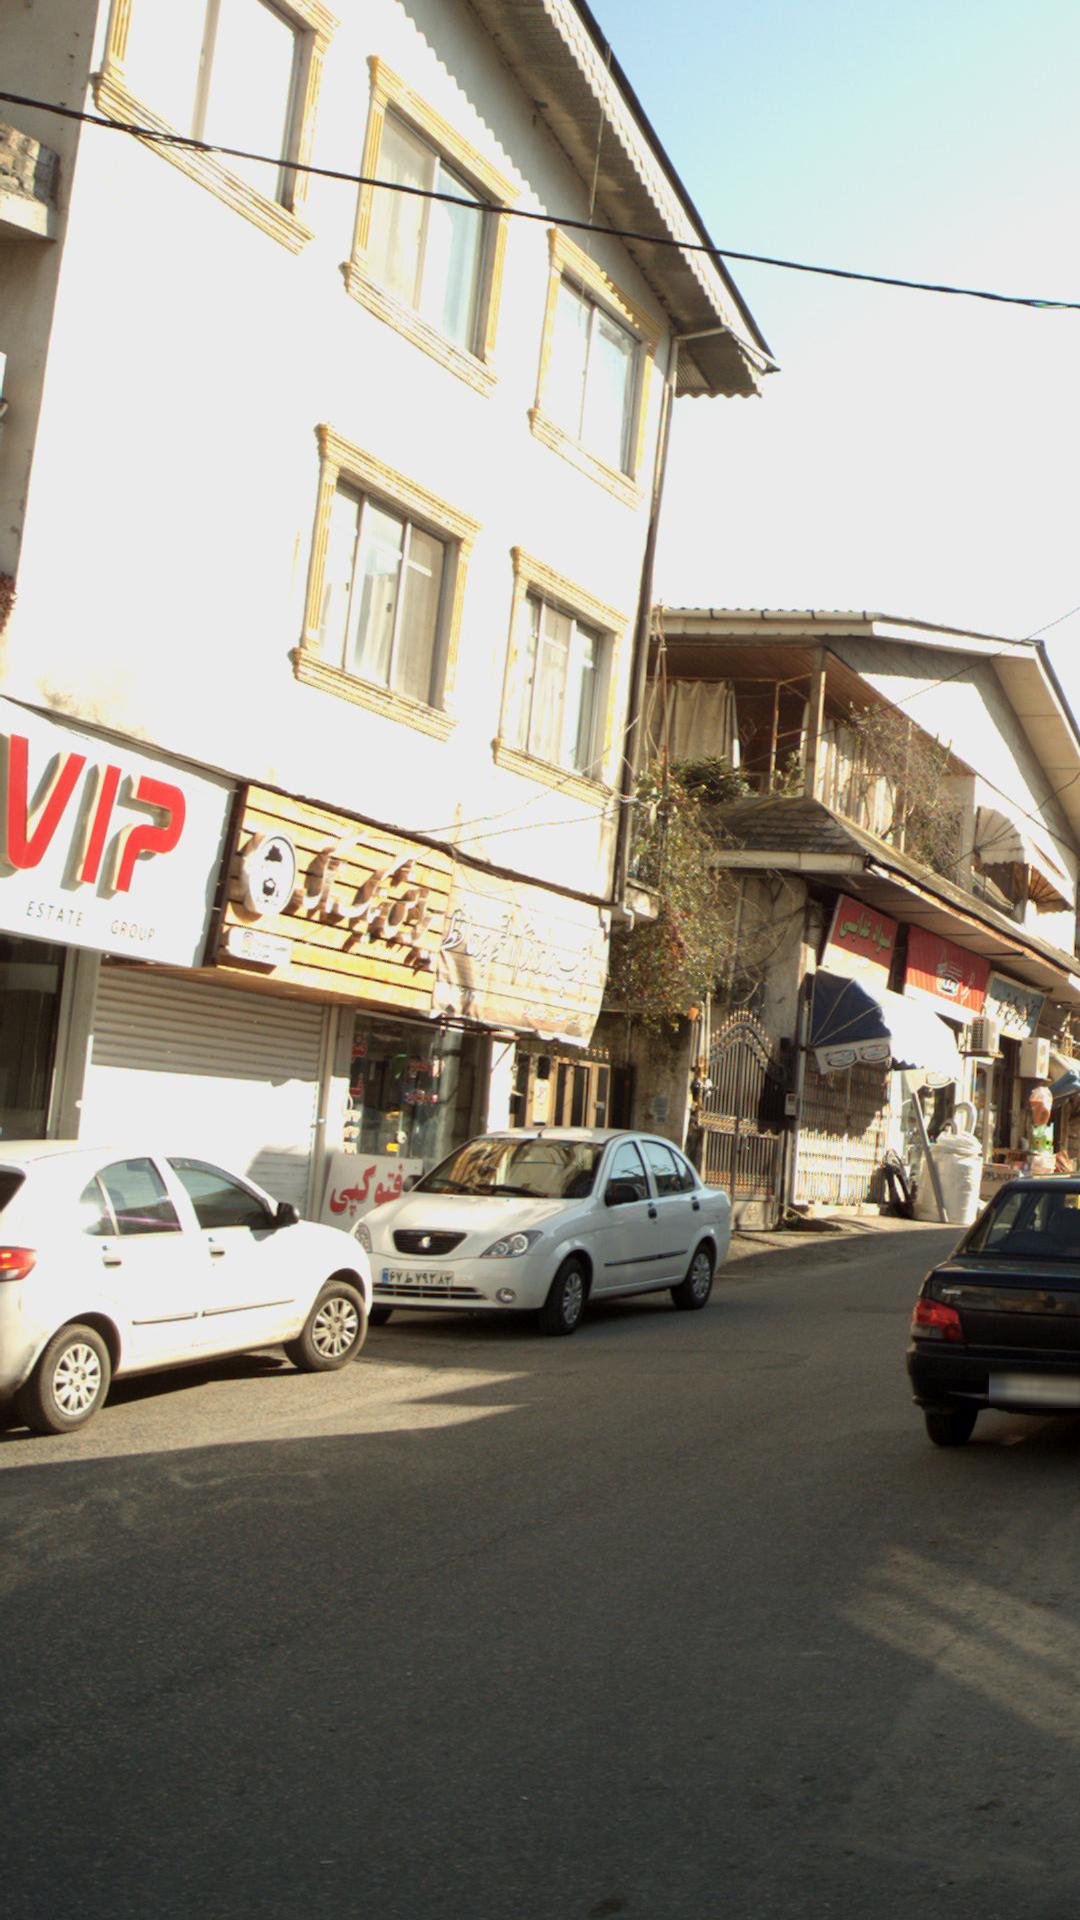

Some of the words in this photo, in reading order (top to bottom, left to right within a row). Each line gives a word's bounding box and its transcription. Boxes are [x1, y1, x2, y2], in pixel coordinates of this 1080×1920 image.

[7, 733, 186, 893] VIP
[26, 900, 84, 928] ESTATE
[110, 919, 157, 942] GROUP
